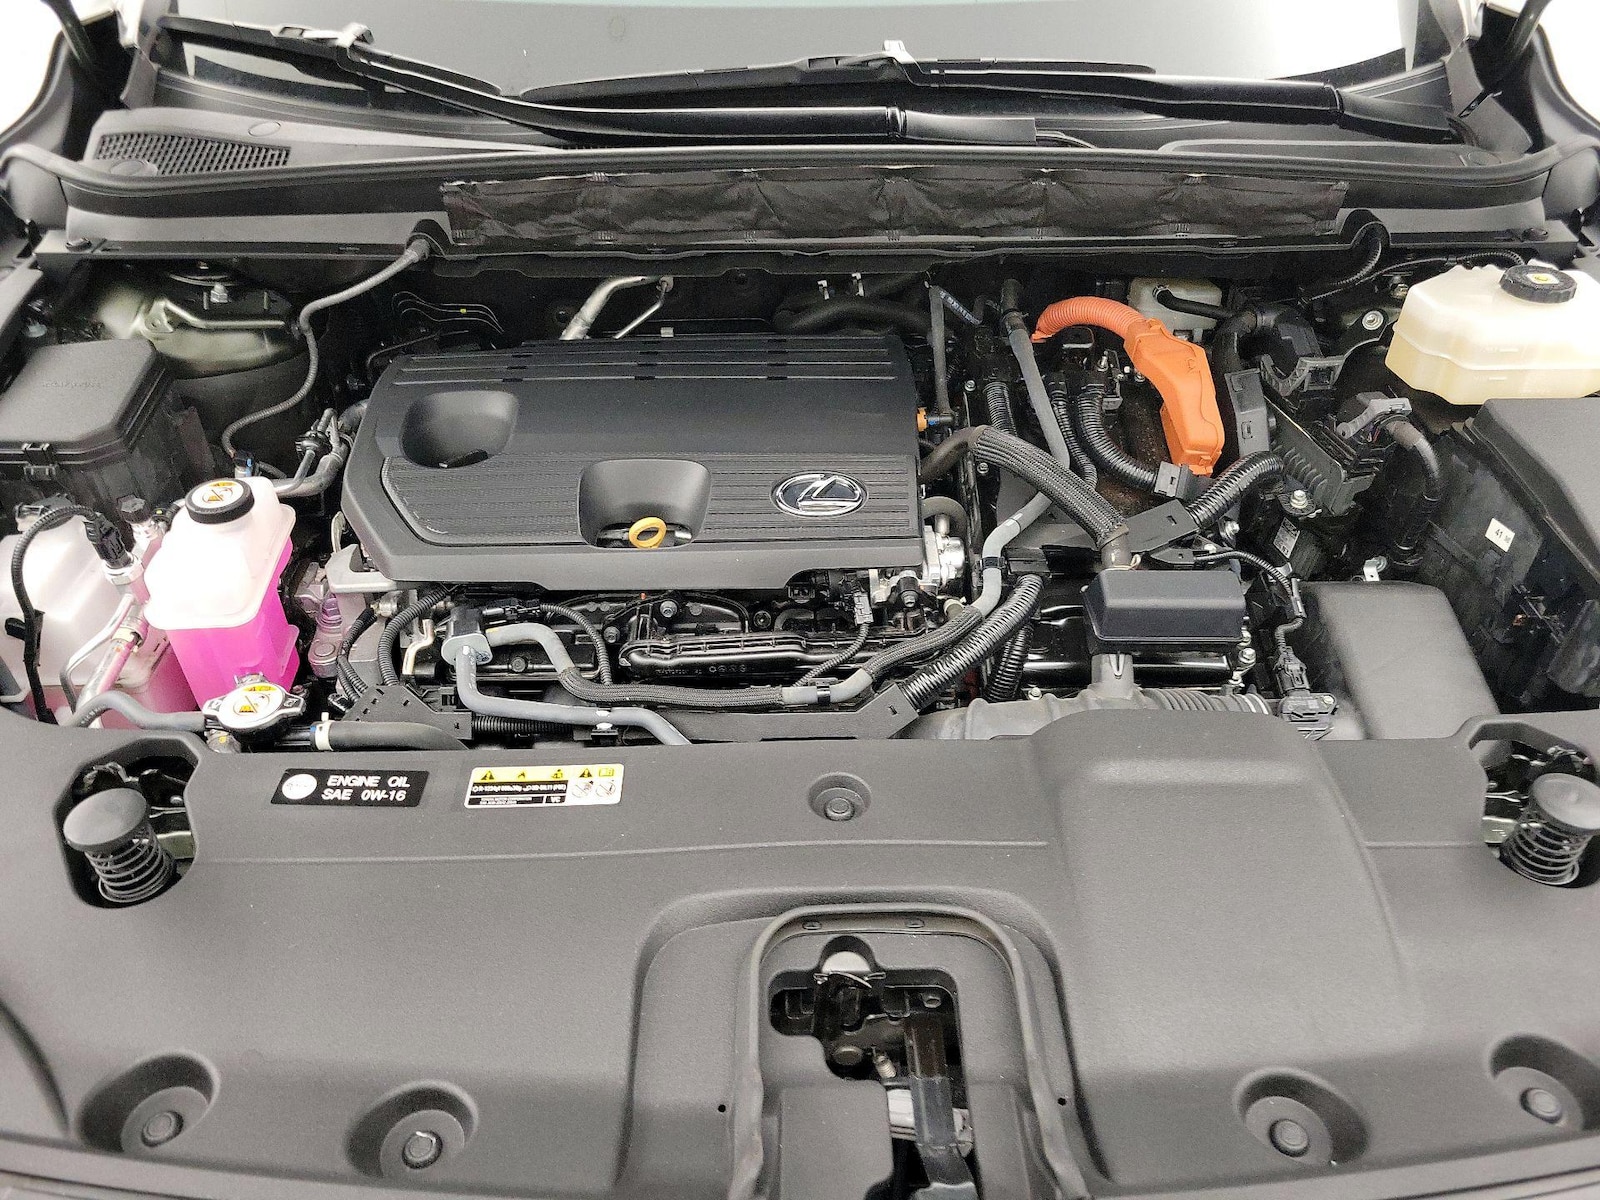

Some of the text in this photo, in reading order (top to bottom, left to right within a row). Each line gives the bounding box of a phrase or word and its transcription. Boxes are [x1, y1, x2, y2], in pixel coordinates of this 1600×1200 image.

[326, 775, 381, 787] ENGINE
[387, 776, 411, 788] OIL
[321, 788, 407, 801] SAE 0W-16
